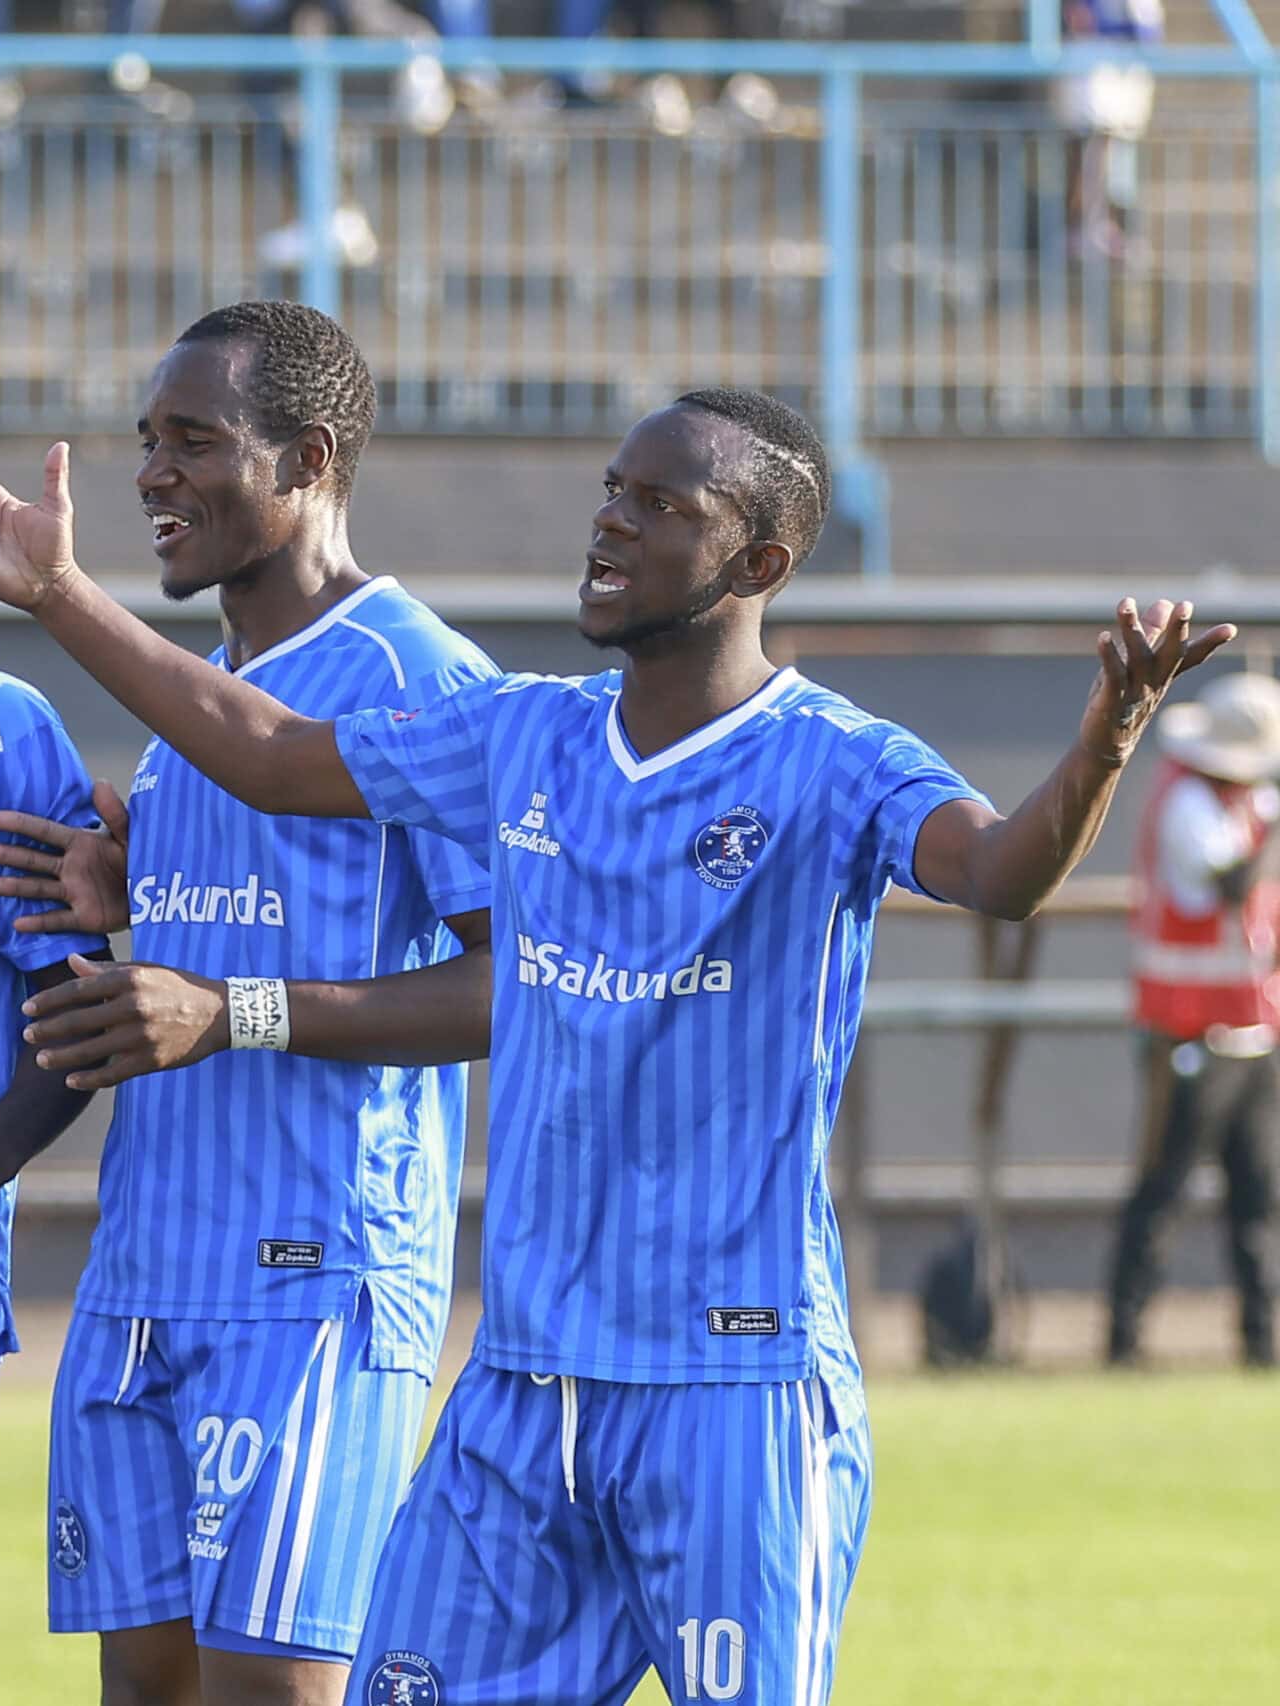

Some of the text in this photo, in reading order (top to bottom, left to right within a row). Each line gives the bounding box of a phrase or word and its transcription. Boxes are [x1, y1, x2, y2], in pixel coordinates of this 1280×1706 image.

[130, 871, 286, 927] Sakunda
[721, 867, 742, 876] 1963
[536, 942, 734, 1003] Sakunda
[195, 1415, 264, 1495] 20
[384, 1651, 431, 1668] DYNAMOS
[676, 1617, 746, 1701] 10
